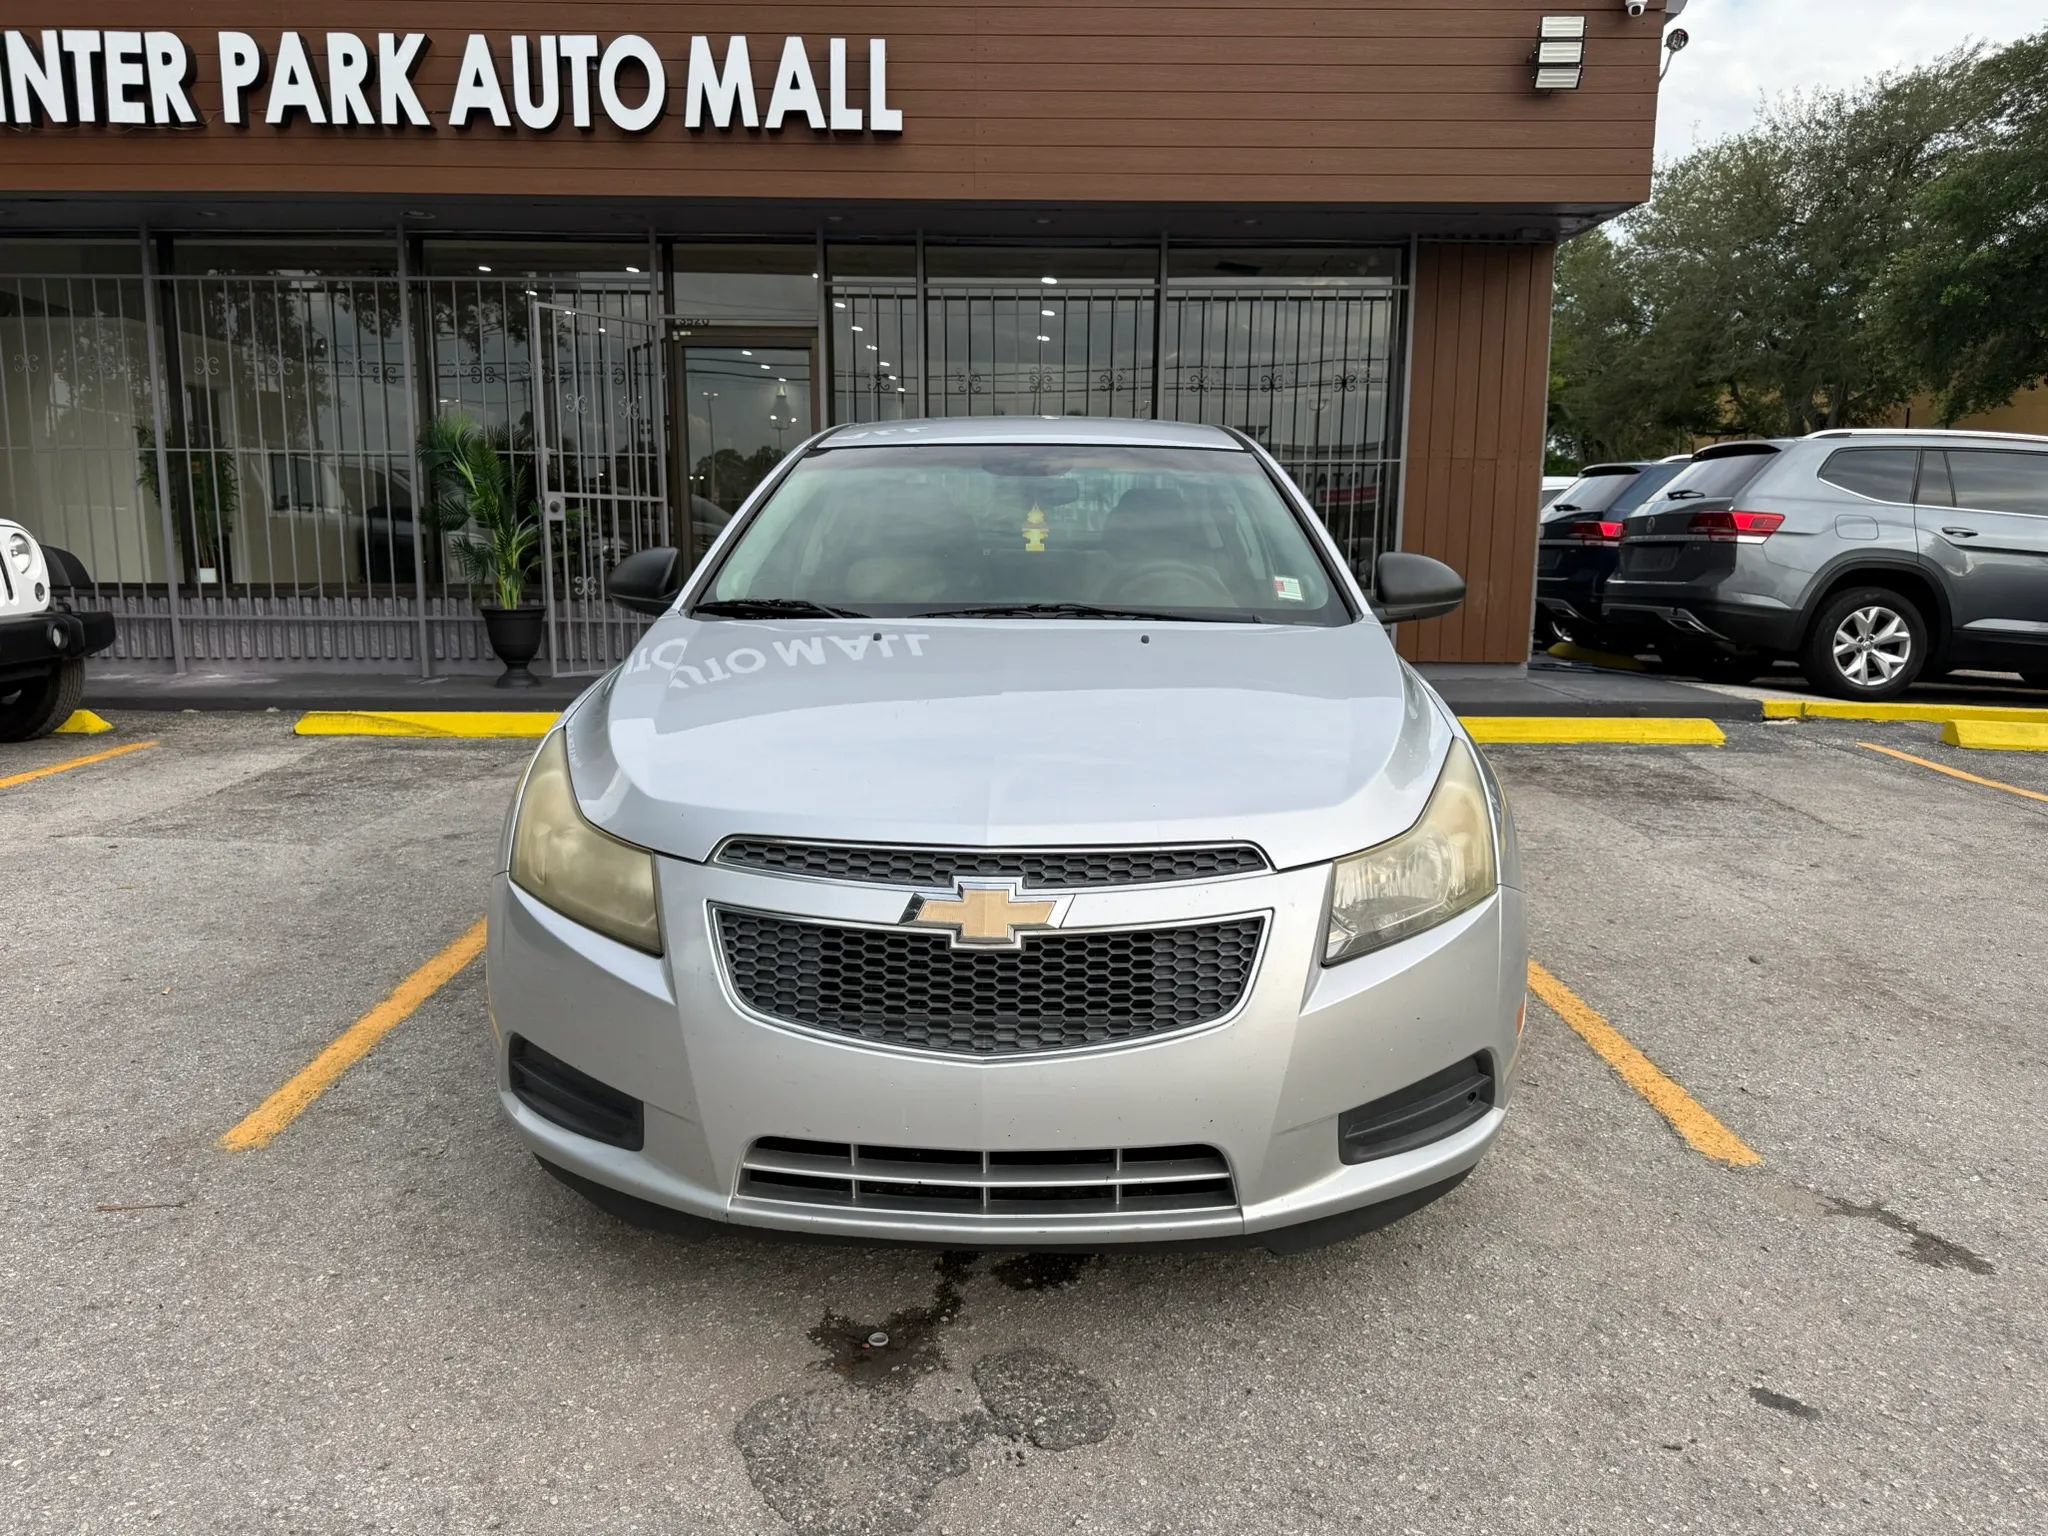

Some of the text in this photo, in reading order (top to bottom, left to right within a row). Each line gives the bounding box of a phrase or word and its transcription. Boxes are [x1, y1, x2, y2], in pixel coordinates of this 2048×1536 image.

[218, 31, 431, 124] PARK
[448, 34, 665, 131] AUTO
[684, 35, 903, 131] MALL
